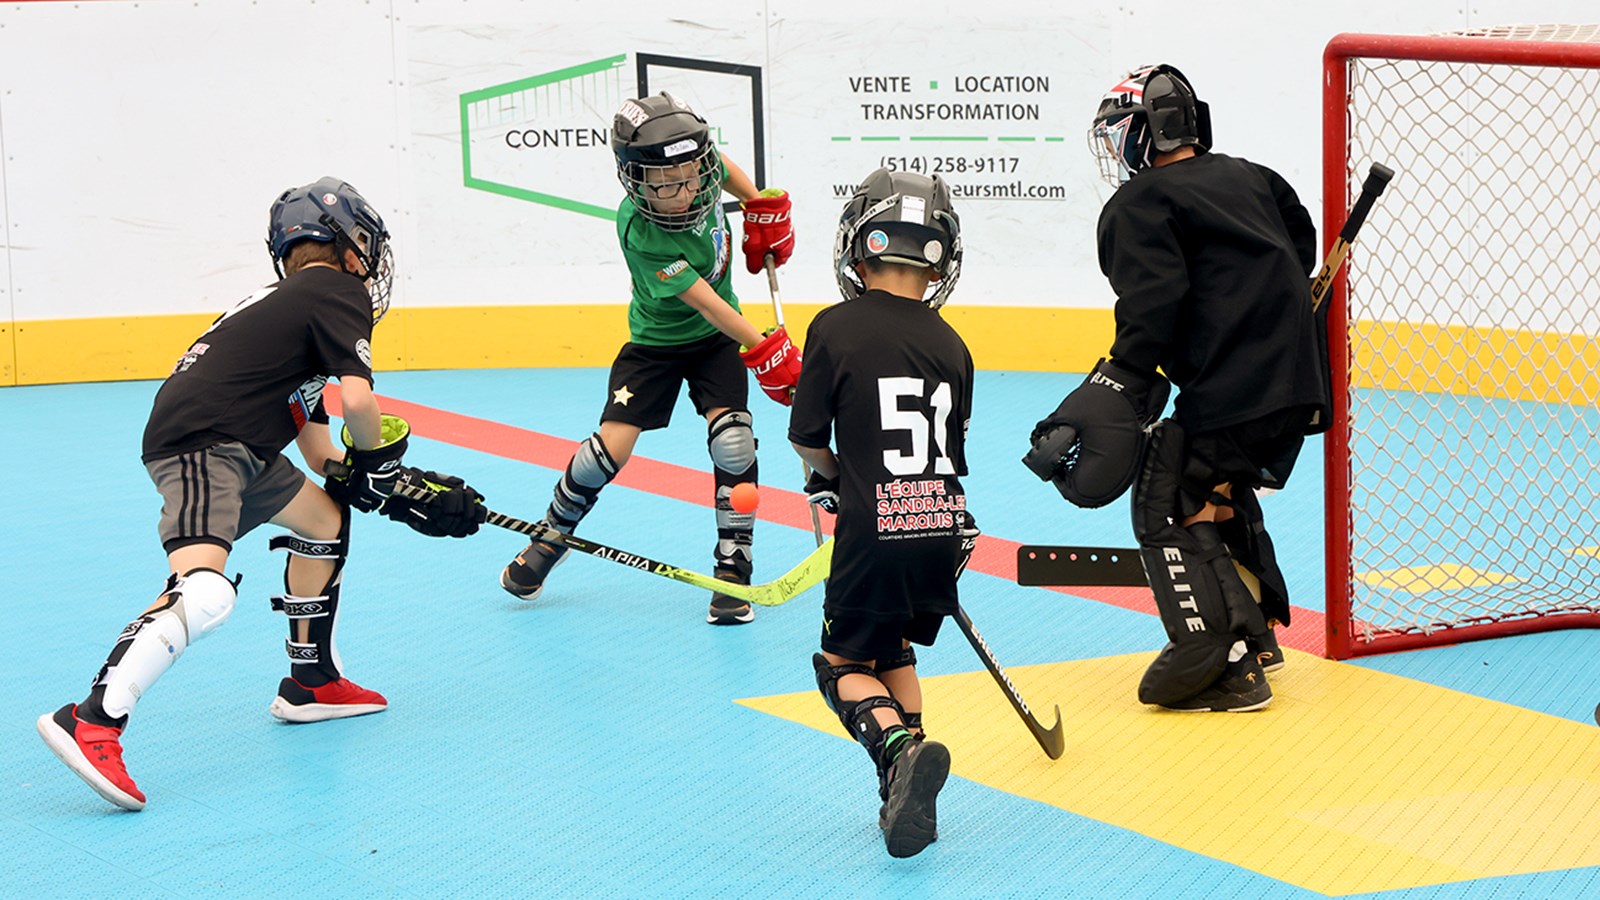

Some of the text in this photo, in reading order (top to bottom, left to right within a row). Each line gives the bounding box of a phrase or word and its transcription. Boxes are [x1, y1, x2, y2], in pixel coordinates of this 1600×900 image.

[848, 76, 1050, 93] VENTE LOCATION
[861, 104, 1040, 121] TRANSFORMATION
[505, 127, 613, 149] CONTEN
[880, 156, 1020, 174] (514) 258-9117
[746, 210, 792, 225] BAU
[750, 339, 793, 376] UER
[877, 377, 956, 476] 51
[876, 479, 946, 499] L'ÉQUIPE
[877, 512, 954, 532] MARQUIS
[592, 547, 650, 571] ALPHA
[1162, 547, 1206, 633] ELITE
